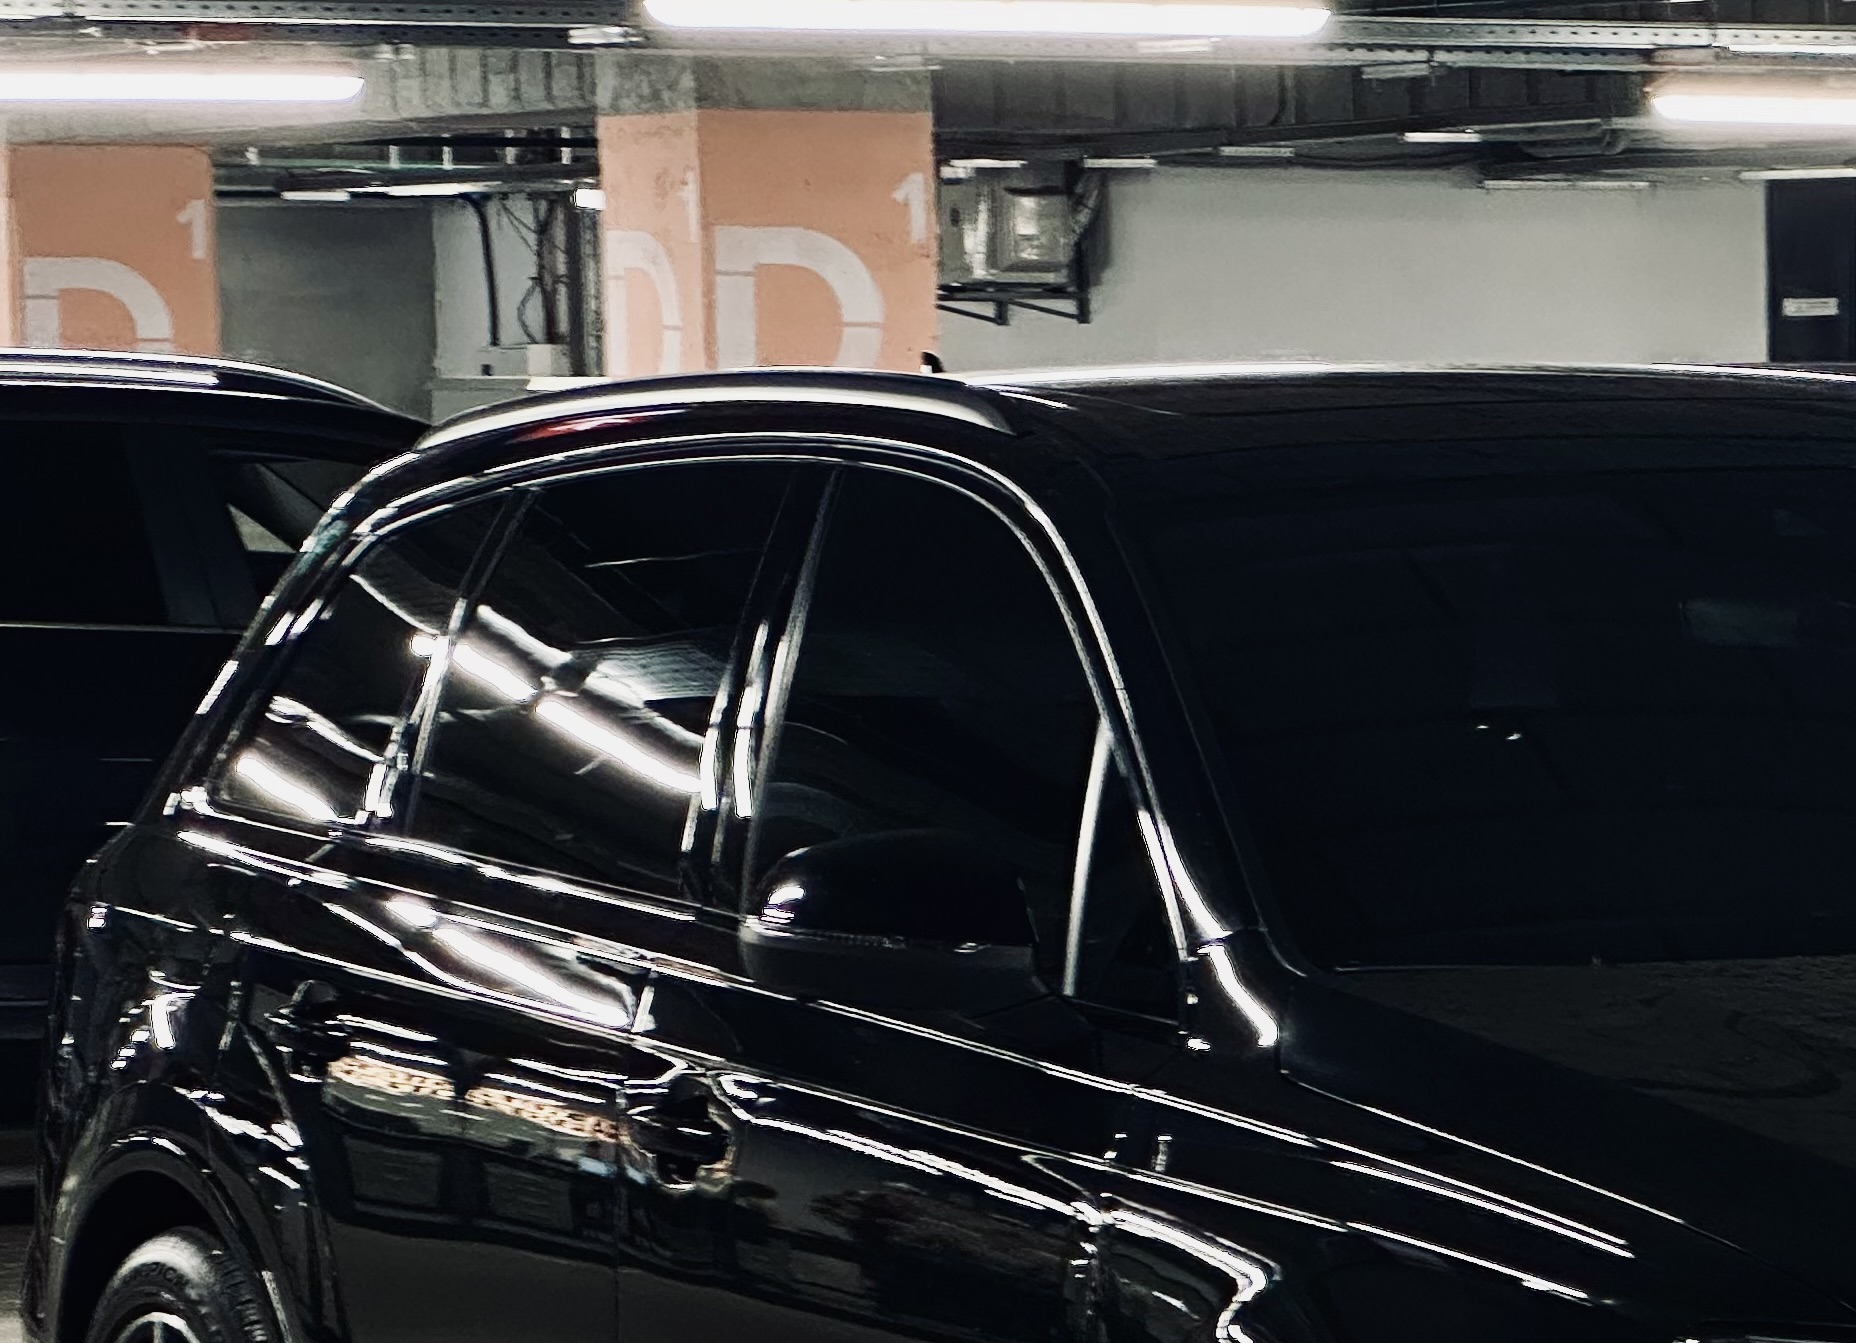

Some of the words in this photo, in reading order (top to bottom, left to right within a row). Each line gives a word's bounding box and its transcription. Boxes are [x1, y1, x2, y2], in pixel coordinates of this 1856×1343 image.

[176, 199, 207, 260] 1
[890, 171, 926, 244] 1
[714, 225, 883, 368] D
